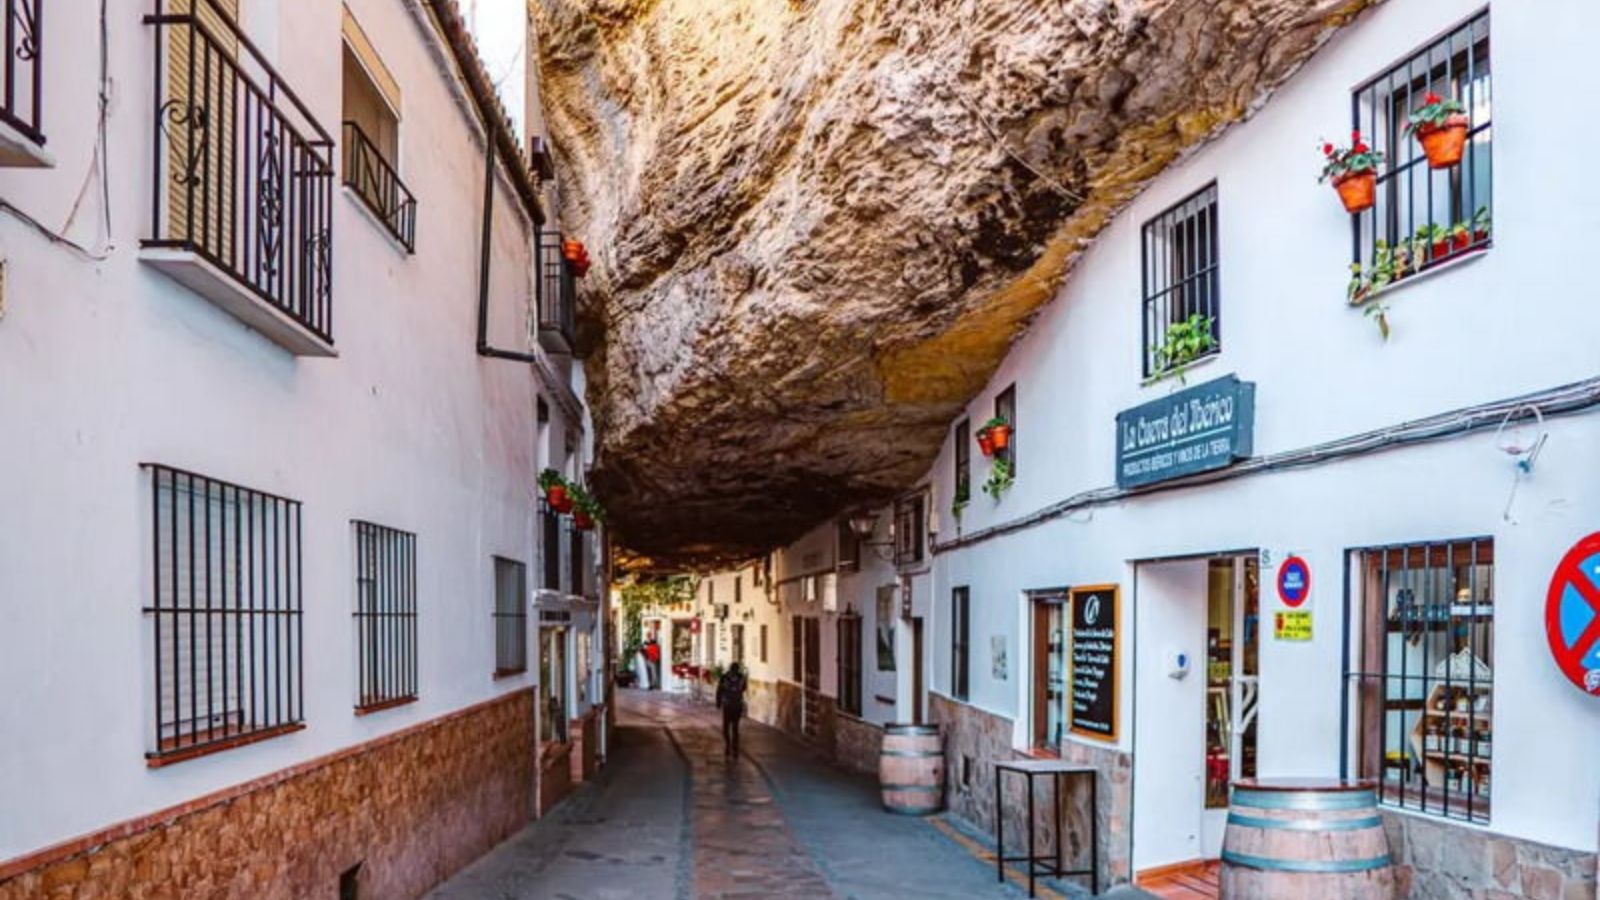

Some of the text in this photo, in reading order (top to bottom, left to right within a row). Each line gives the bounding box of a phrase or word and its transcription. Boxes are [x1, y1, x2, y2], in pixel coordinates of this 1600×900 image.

[1123, 421, 1136, 450] La
[1138, 416, 1168, 445] Cueva
[1171, 403, 1188, 436] del
